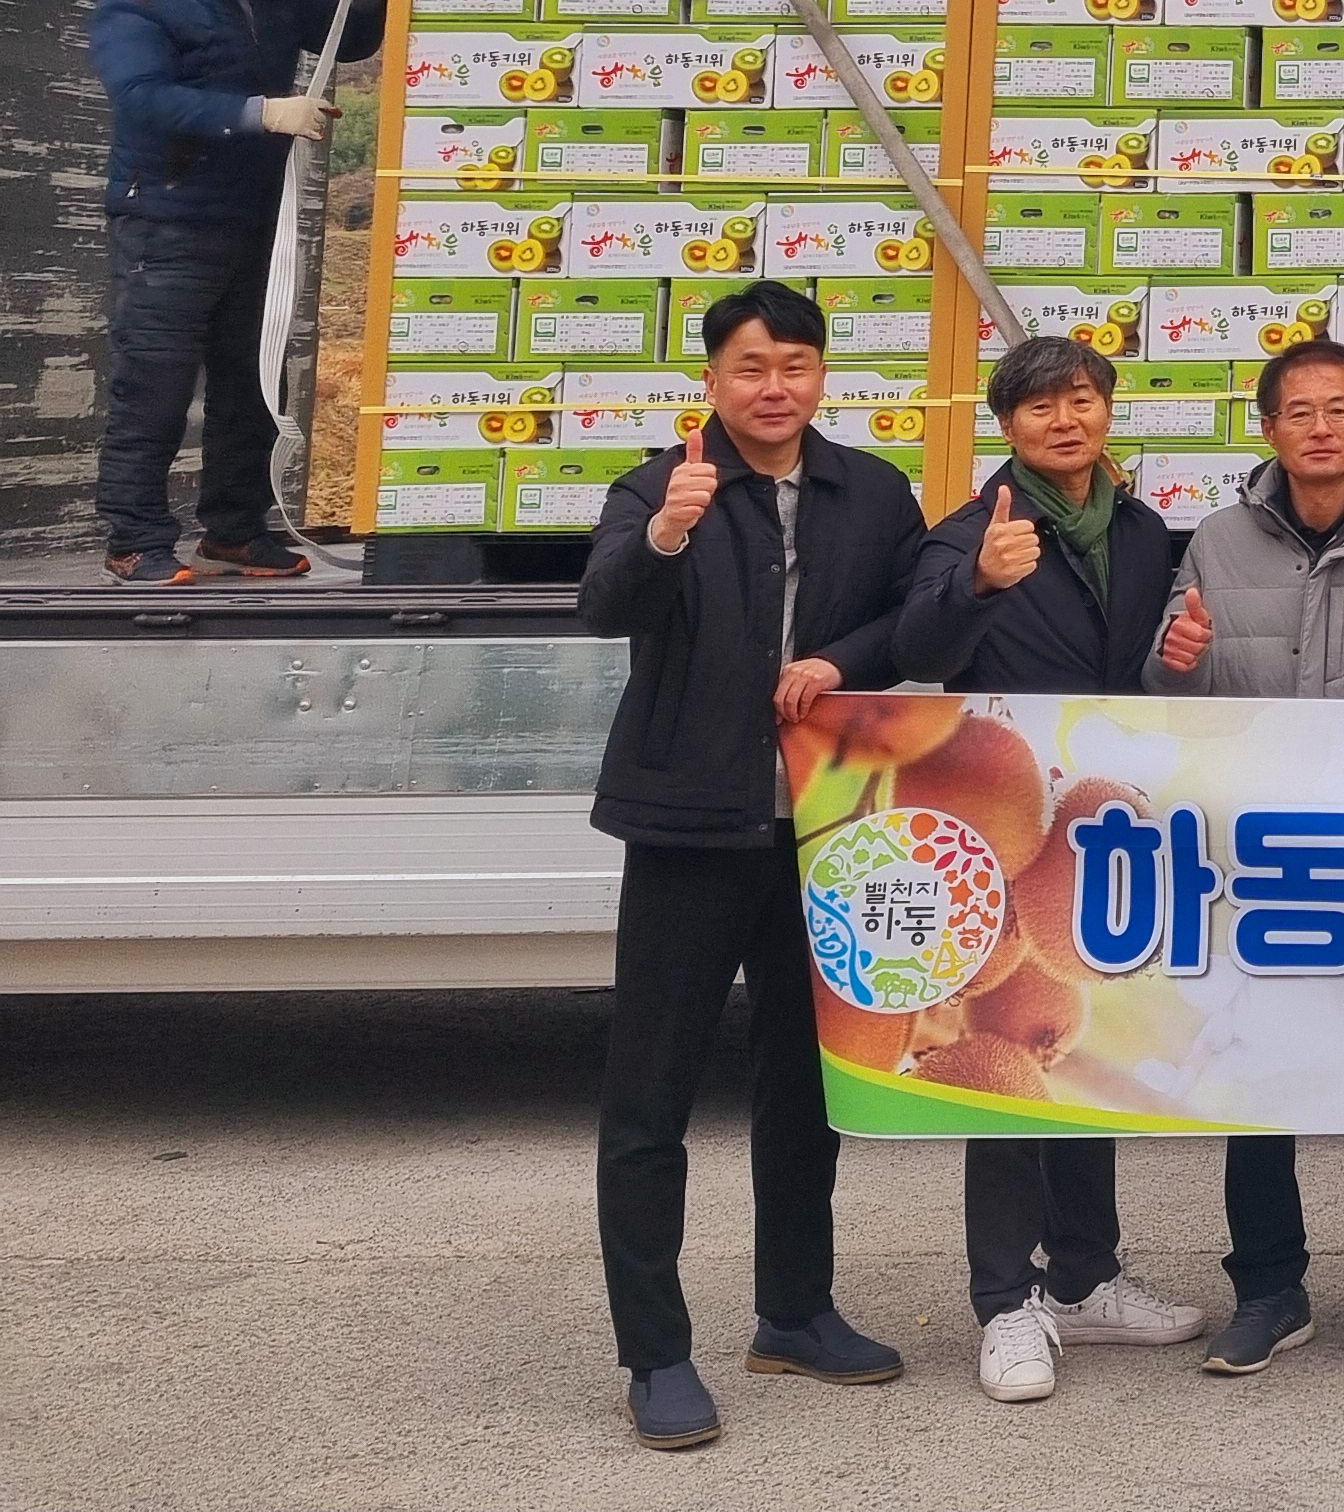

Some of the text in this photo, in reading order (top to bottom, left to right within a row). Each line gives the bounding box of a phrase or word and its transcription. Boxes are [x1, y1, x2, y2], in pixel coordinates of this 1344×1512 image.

[473, 51, 531, 68] 하동키위
[665, 52, 723, 69] 하동키위
[856, 52, 915, 69] 하동키위
[1052, 136, 1108, 153] 하동키위
[1241, 136, 1297, 153] 하동키위
[461, 220, 520, 237] 하동키위
[655, 220, 714, 237] 하동키위
[848, 220, 906, 237] 하동키위
[1042, 304, 1099, 321] 하동키위
[1231, 304, 1288, 321] 하동키위
[452, 391, 511, 406] 하동키위
[865, 878, 939, 905] 별천지
[861, 905, 937, 947] 하동
